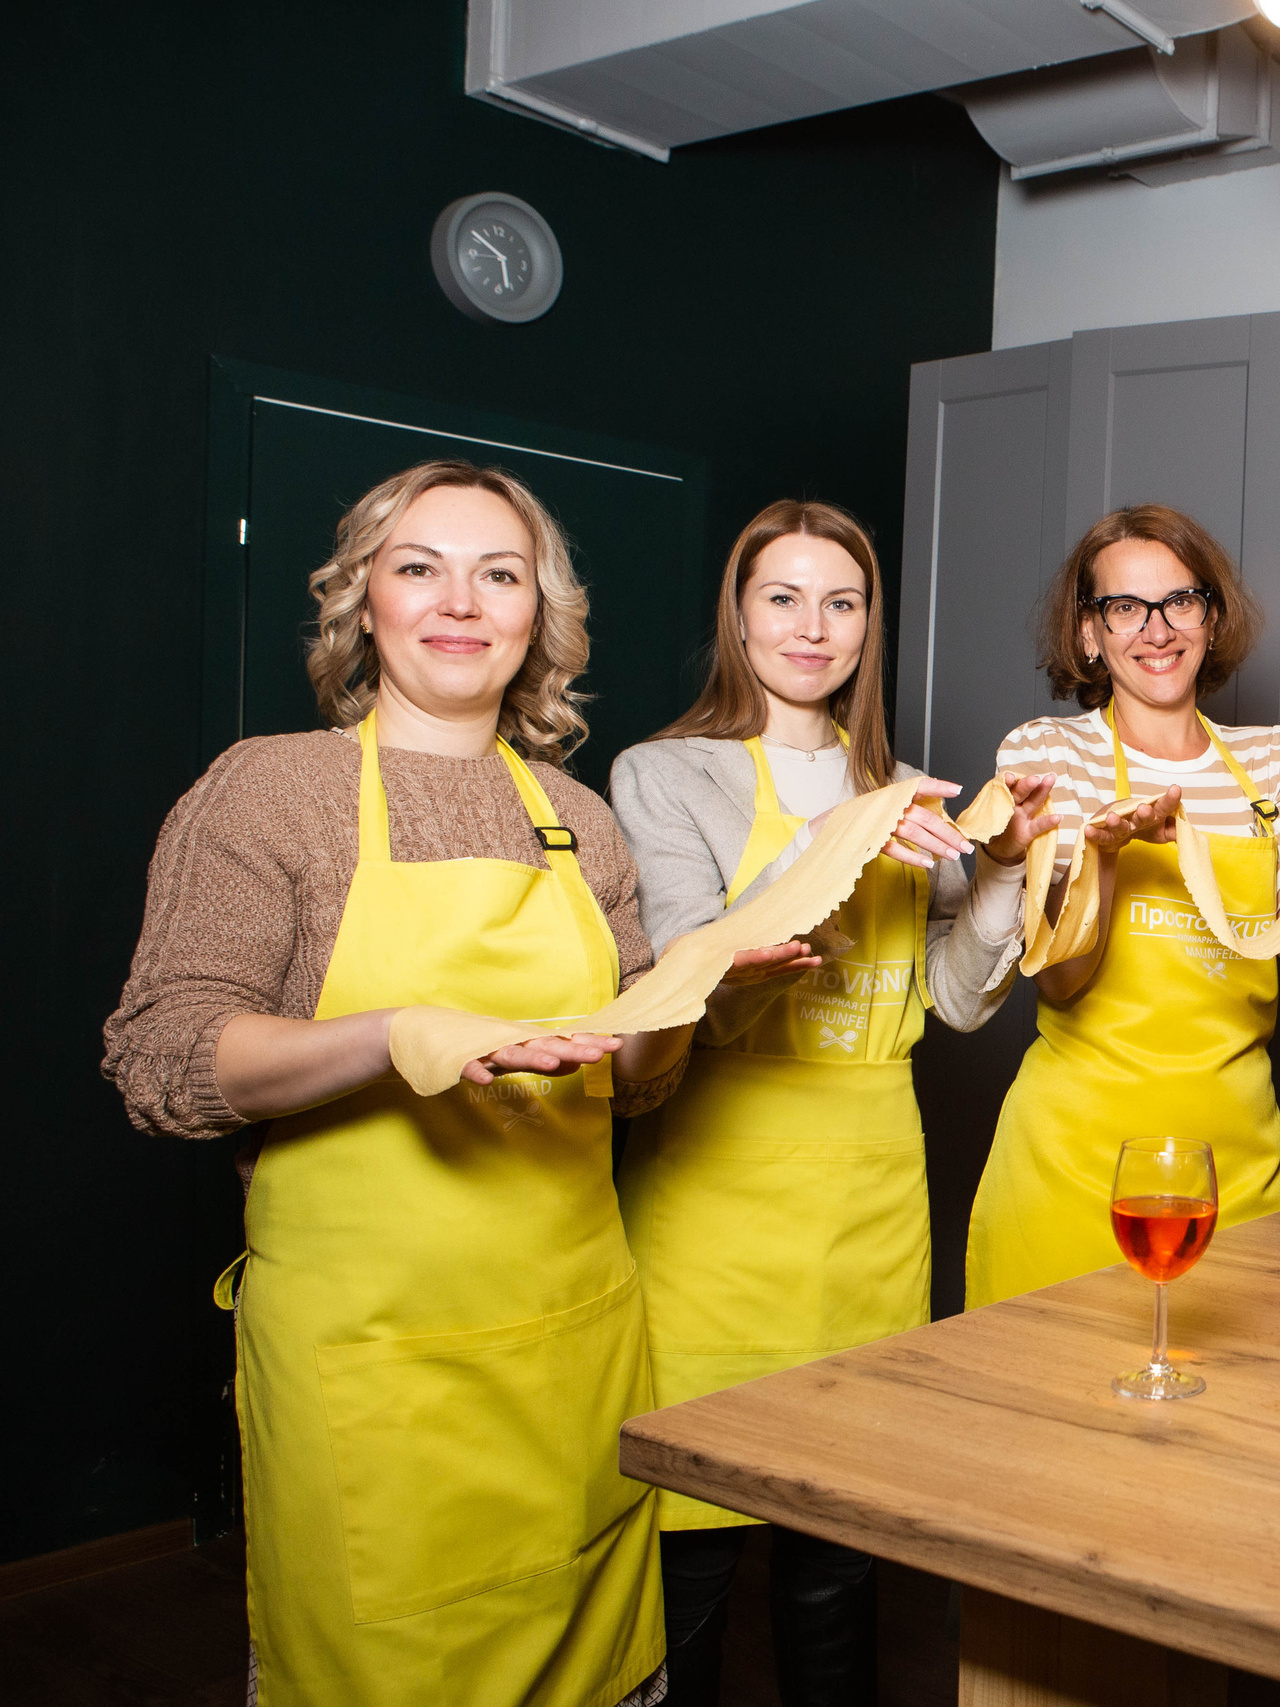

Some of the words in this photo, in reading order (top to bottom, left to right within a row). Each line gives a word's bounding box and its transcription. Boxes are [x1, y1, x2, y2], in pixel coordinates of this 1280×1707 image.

[492, 225, 505, 238] 12
[494, 283, 503, 295] 6
[800, 1005, 868, 1030] MAUNFEL
